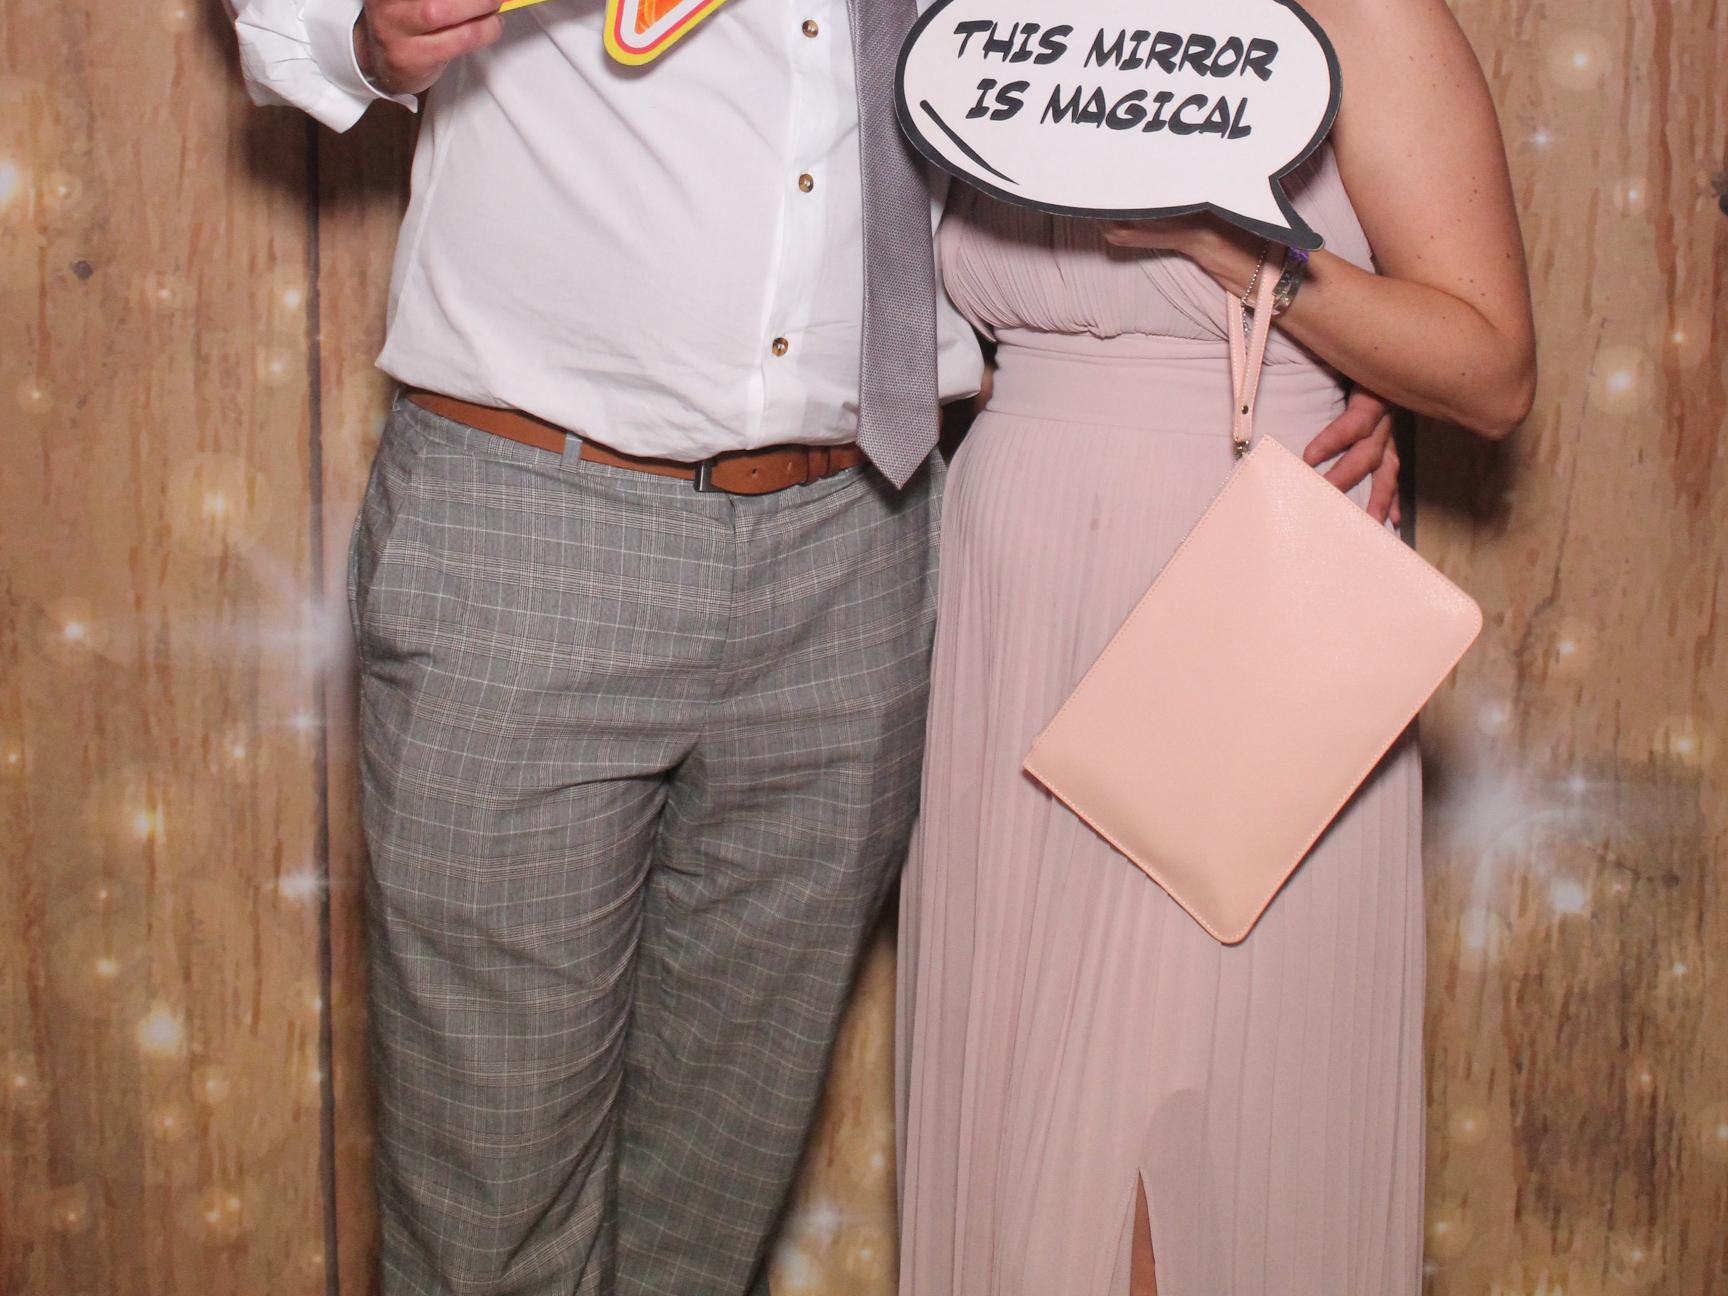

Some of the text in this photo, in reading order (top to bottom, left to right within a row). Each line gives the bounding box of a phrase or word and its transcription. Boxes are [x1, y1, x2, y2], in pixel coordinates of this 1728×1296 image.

[953, 20, 1279, 82] THIS MIRROR
[965, 78, 1252, 140] IS MAGICAL
